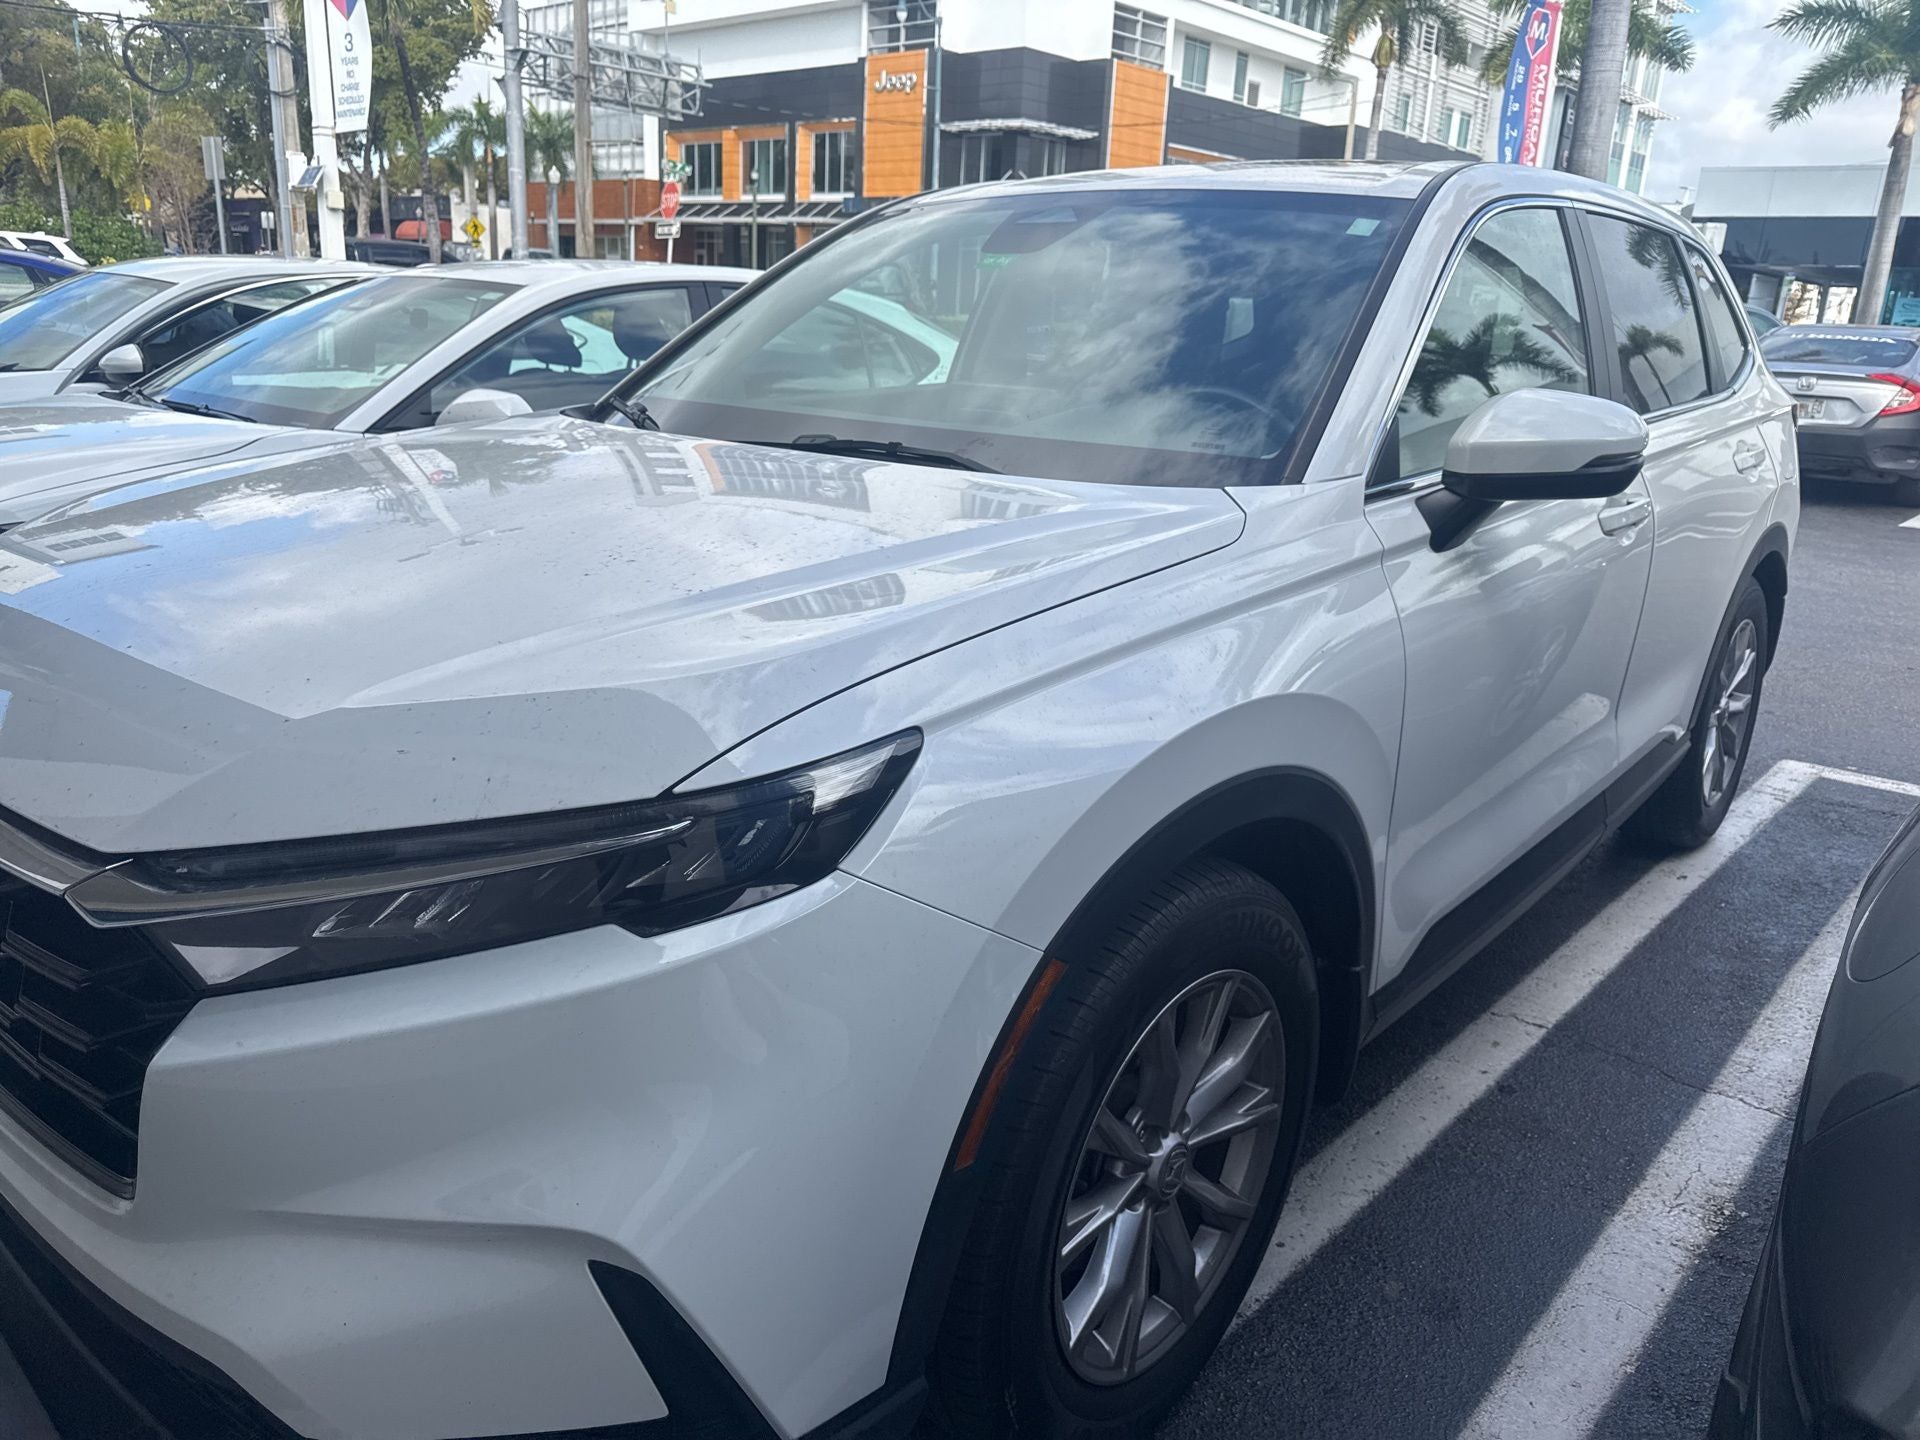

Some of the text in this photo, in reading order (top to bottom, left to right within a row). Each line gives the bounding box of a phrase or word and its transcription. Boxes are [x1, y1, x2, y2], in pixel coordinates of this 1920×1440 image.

[1530, 20, 1546, 40] M
[345, 33, 353, 52] 3
[341, 57, 358, 65] YEARS
[874, 70, 917, 93] Jeep
[662, 191, 678, 209] STOP
